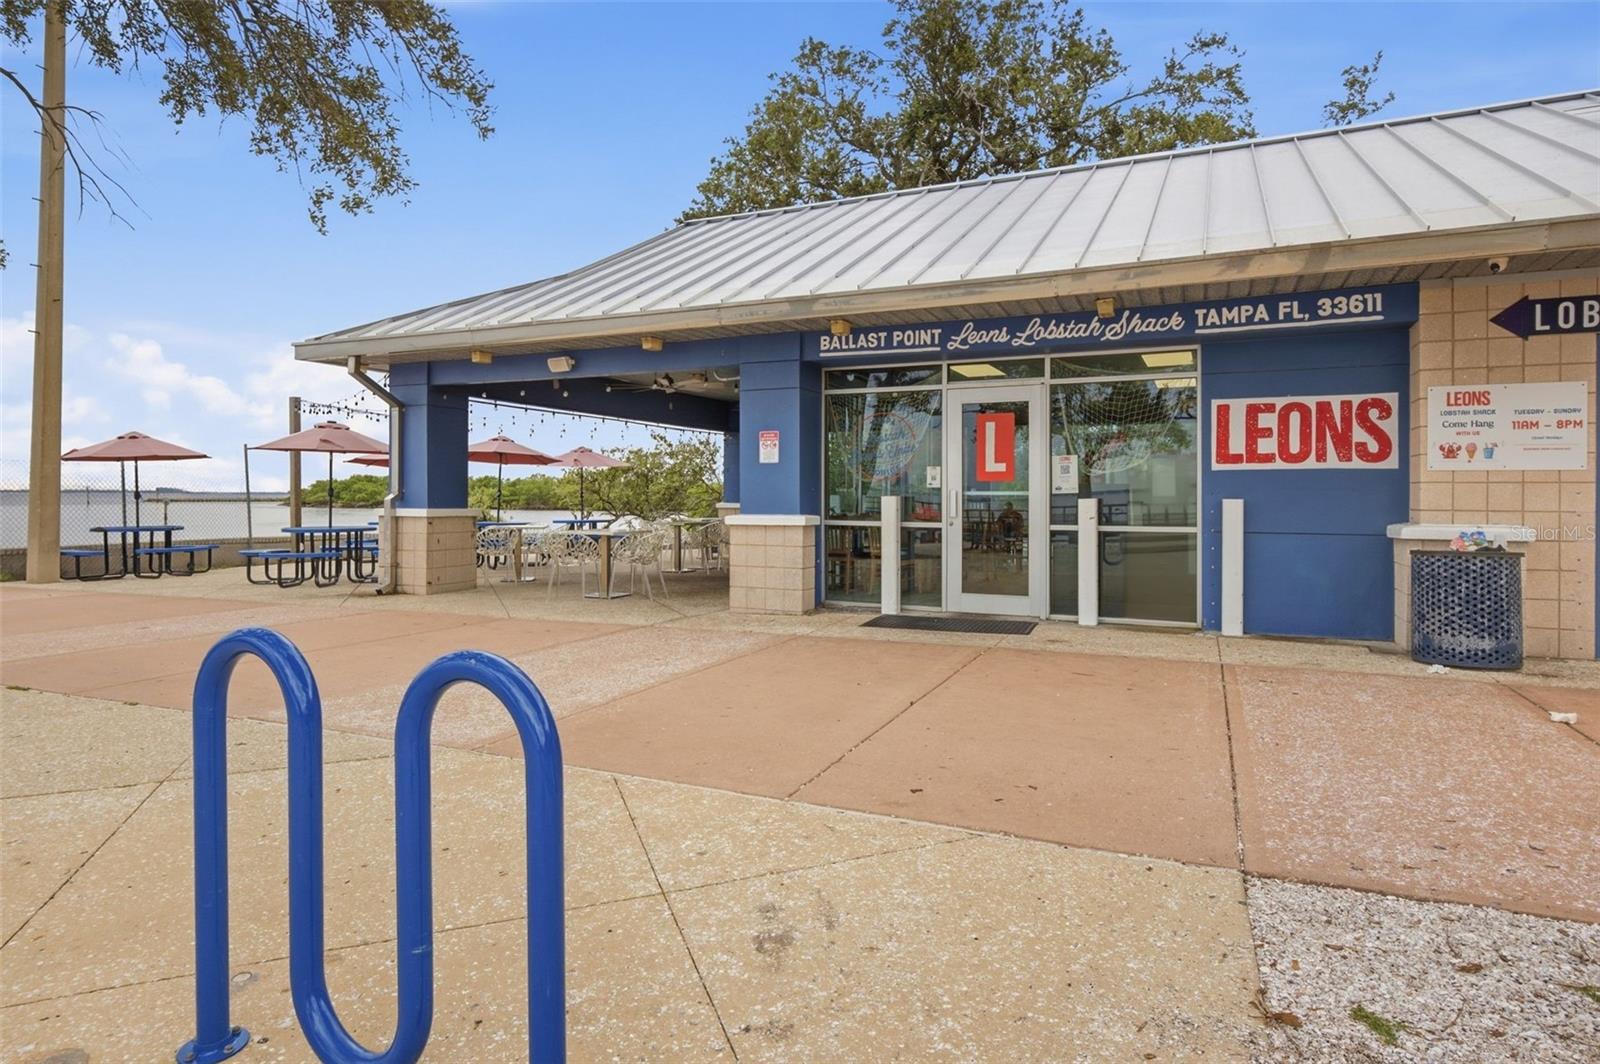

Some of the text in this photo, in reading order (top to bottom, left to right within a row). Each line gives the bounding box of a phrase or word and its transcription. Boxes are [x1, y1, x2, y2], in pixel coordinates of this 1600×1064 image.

[1194, 292, 1383, 327] TAMPA FL, 33611
[1535, 300, 1600, 331] LOB
[819, 328, 942, 351] BALLAST POINT
[947, 310, 1185, 350] Leons Lobstah Shack
[1446, 390, 1491, 407] LEONS
[1215, 397, 1393, 465] LEONS
[1442, 419, 1494, 429] Come Hang
[1512, 420, 1540, 430] 11AM
[1556, 419, 1584, 430] 8PM
[985, 421, 1007, 473] L
